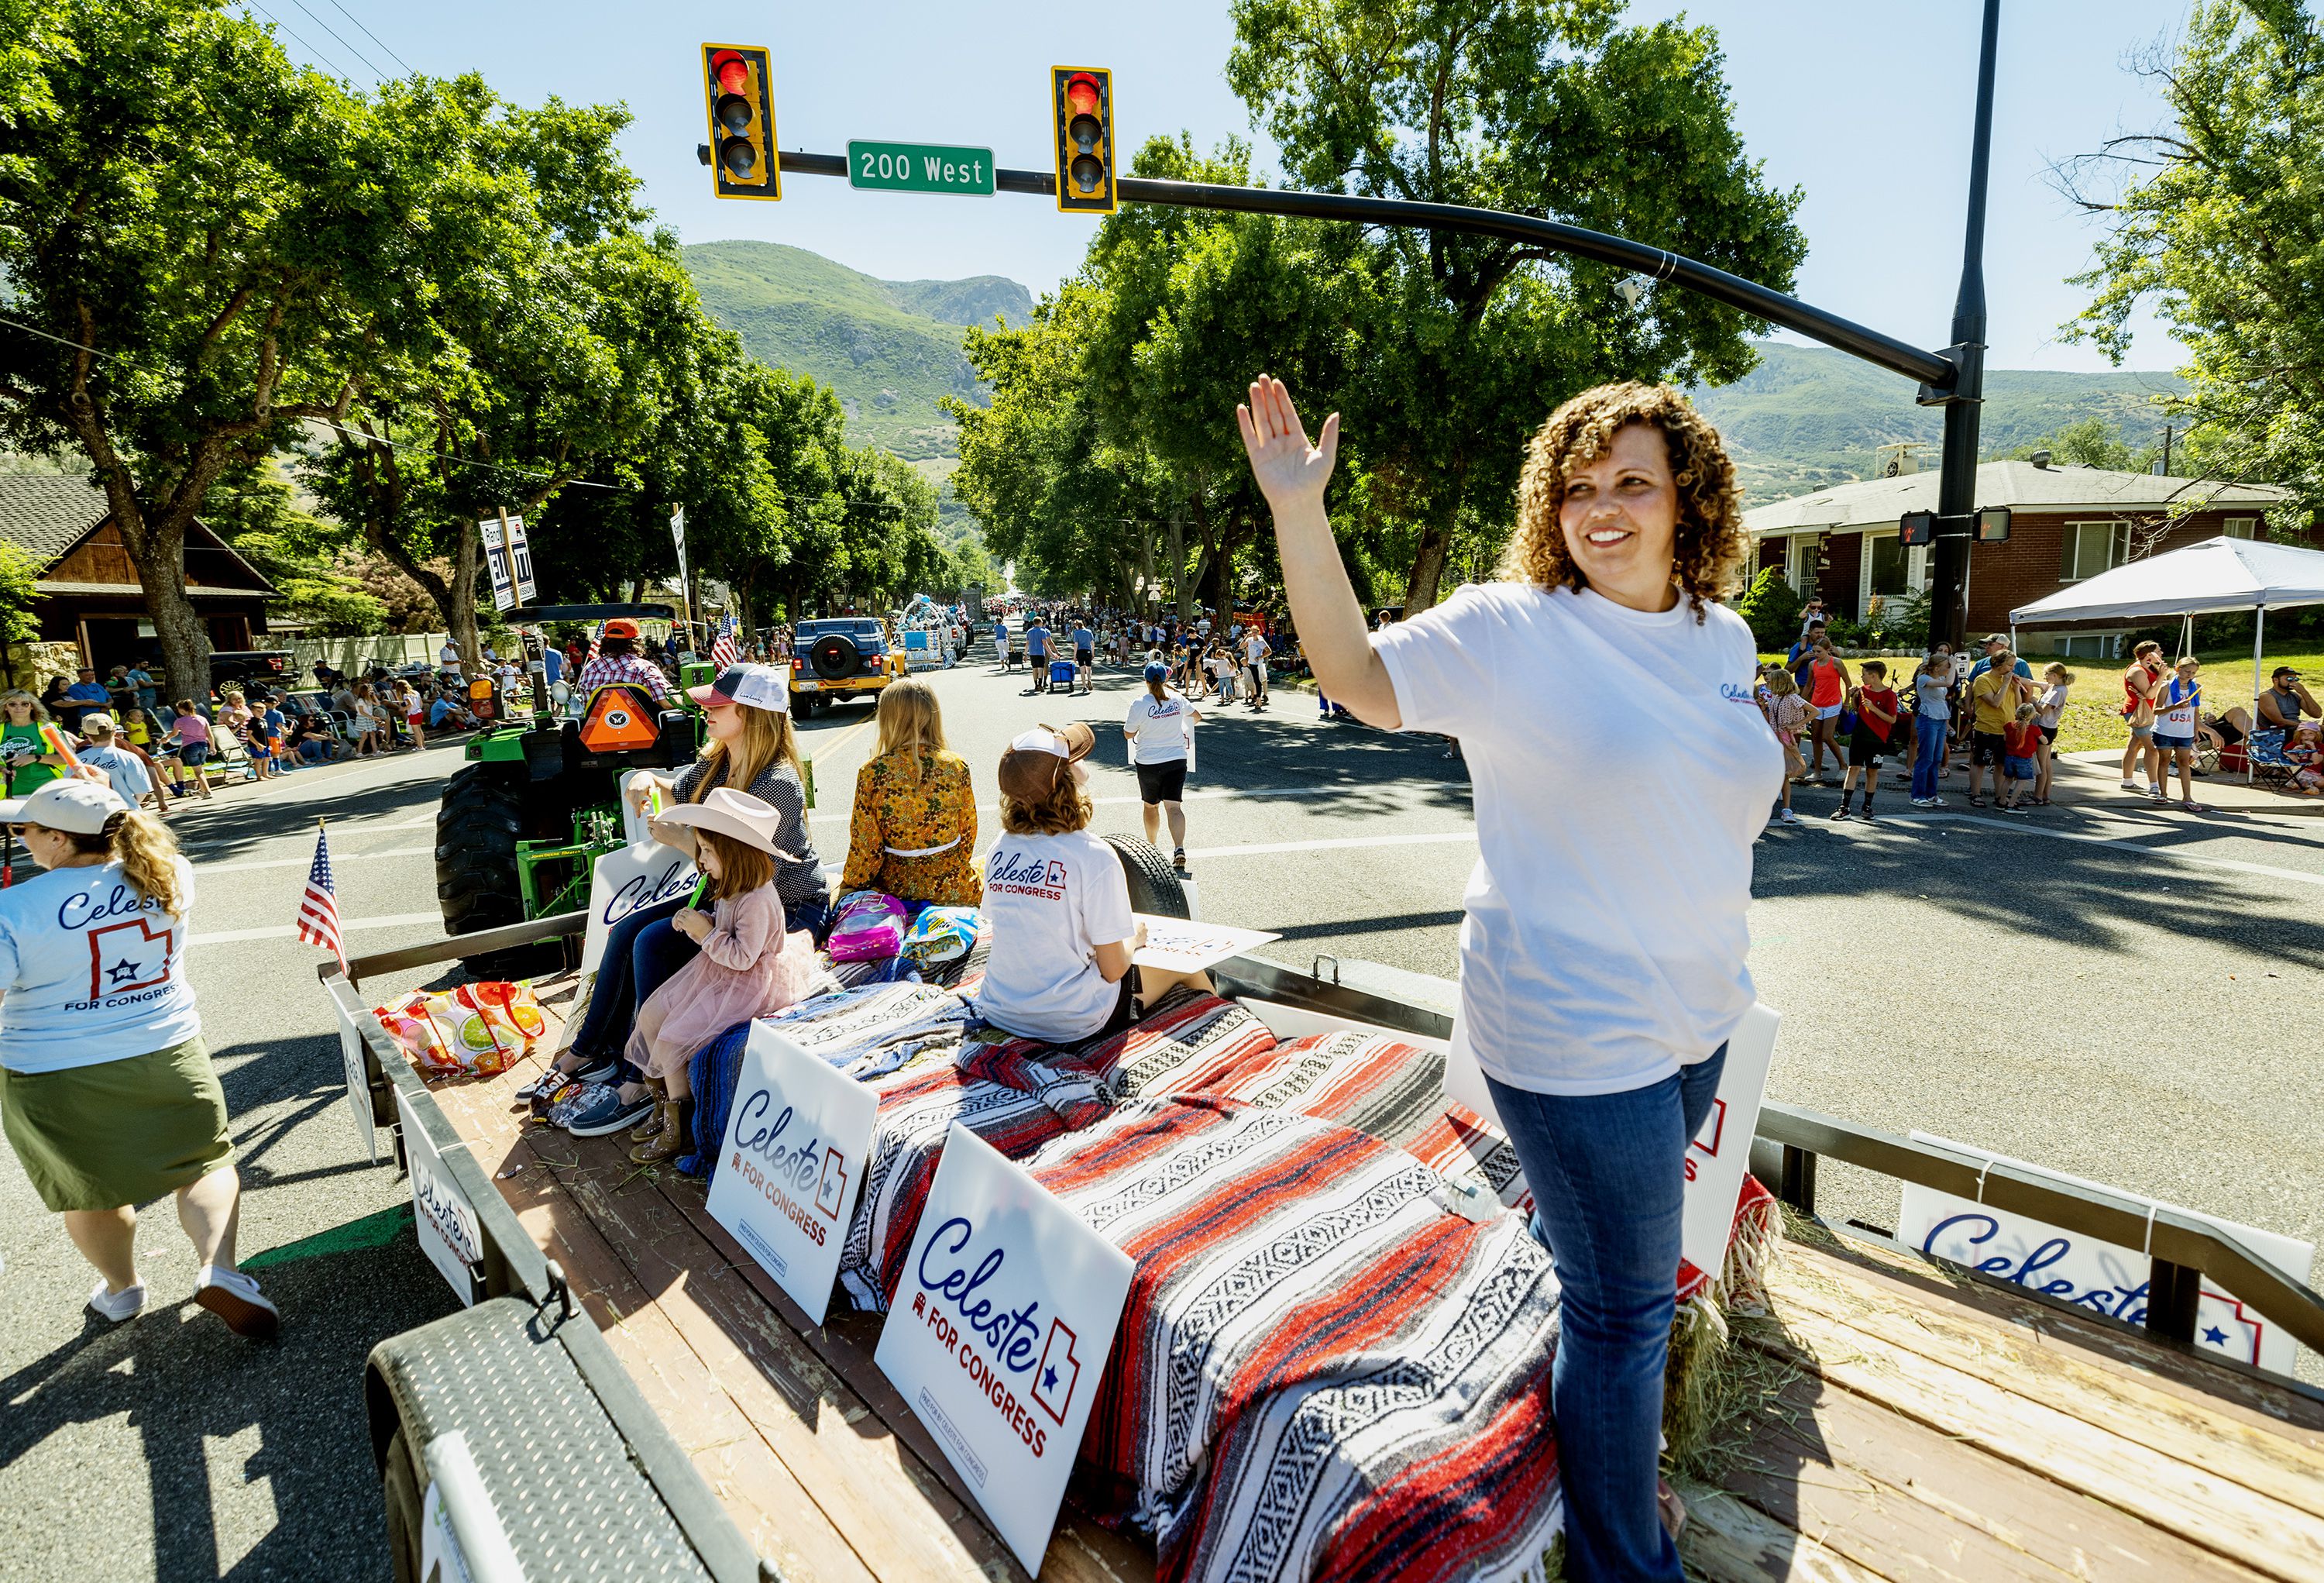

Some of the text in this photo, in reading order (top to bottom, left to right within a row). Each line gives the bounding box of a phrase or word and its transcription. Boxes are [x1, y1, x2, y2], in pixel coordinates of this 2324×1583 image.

[861, 153, 982, 184] 200 West
[1148, 704, 1174, 718] Celeste
[2170, 714, 2192, 722] USA
[988, 852, 1045, 883] Celeste
[58, 885, 161, 930] Celes
[603, 861, 701, 925] Celes
[989, 883, 1061, 900] FOR CONGRESS
[64, 984, 179, 1011] FOR CONGRES
[535, 1072, 569, 1099] Roll
[734, 1089, 818, 1192] Celeste
[411, 1150, 462, 1241] Celeste
[742, 1161, 827, 1247] FOR CONGRESS
[425, 1210, 440, 1236] FOR
[919, 1217, 1039, 1373] Celeste
[927, 1306, 1047, 1458] FOR CONGRESS
[922, 1393, 930, 1408] PAID
[937, 1413, 943, 1423] BY
[941, 1420, 957, 1444] CELESTE
[956, 1438, 965, 1453] FOR
[964, 1450, 985, 1481] CONGRESS
